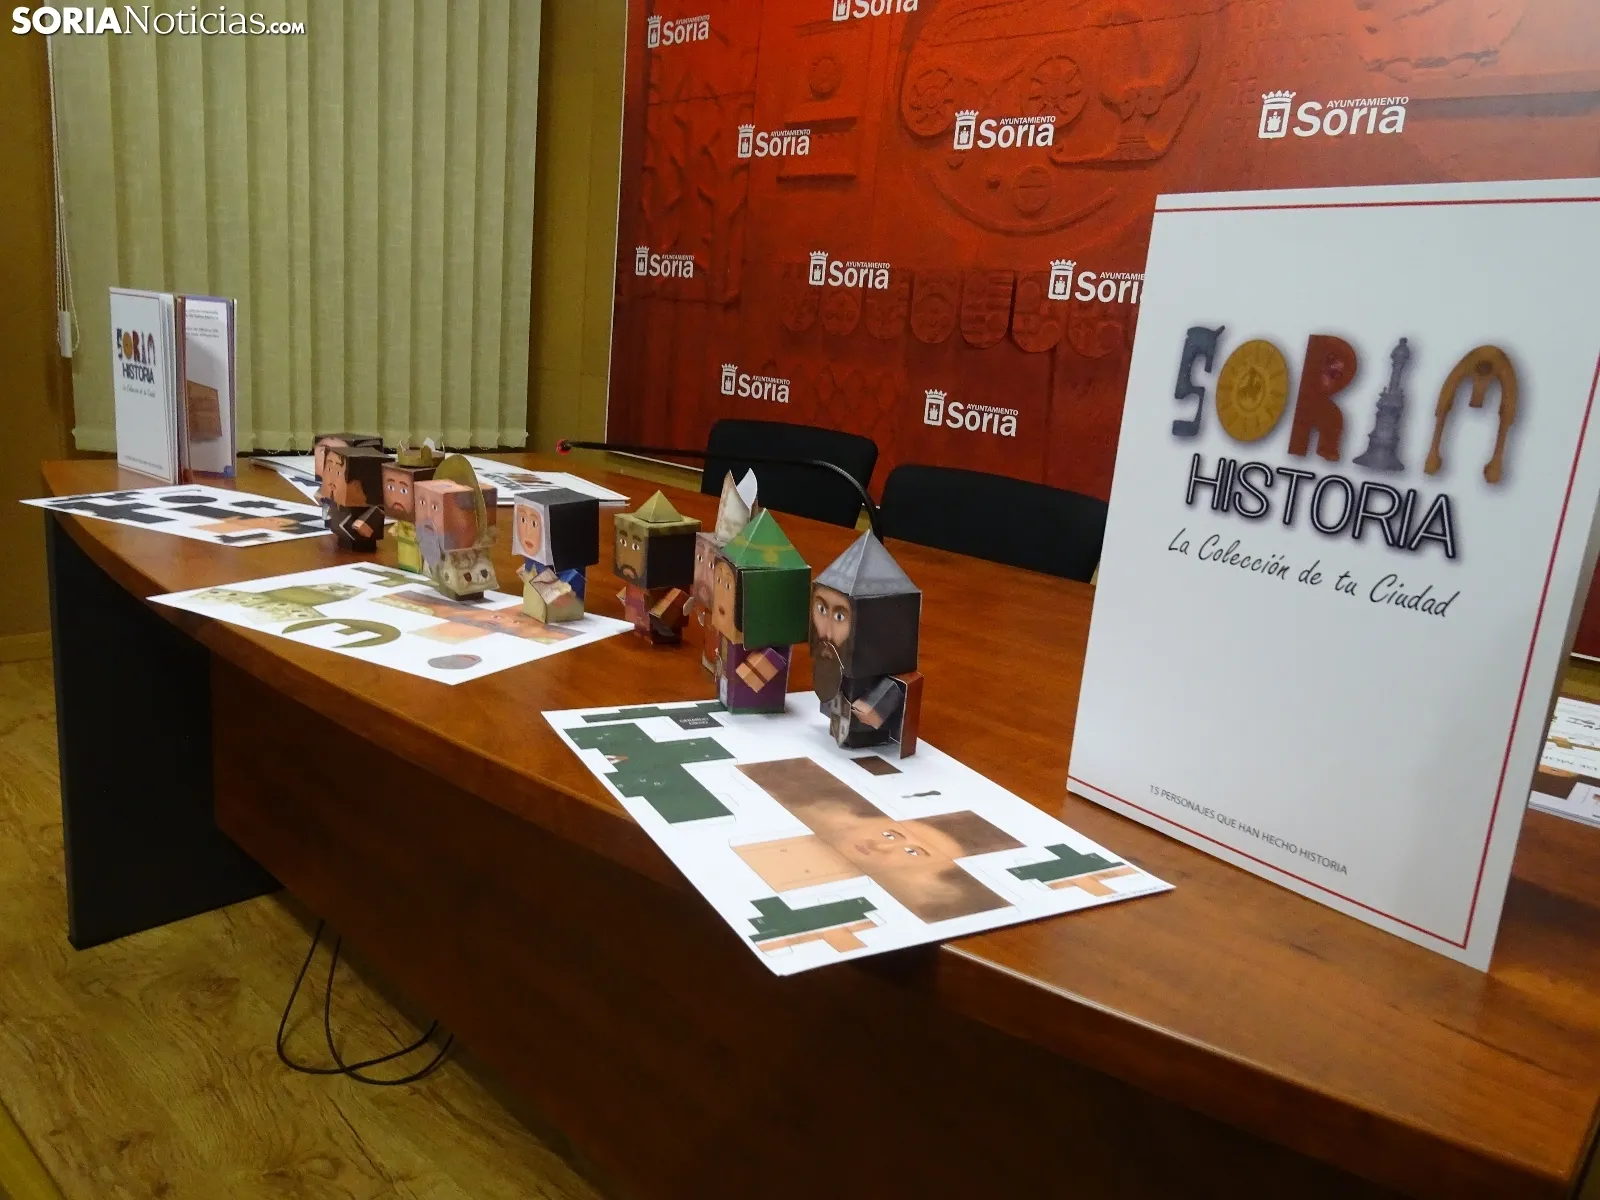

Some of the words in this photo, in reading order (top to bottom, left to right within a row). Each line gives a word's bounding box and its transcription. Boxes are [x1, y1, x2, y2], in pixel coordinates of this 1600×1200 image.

[662, 20, 710, 46] Soria
[675, 15, 710, 25] AYUNTAMIENTO
[1327, 96, 1409, 108] AYUNTAMIENTO
[1000, 115, 1056, 125] AYUNTAMIENTO
[1293, 101, 1408, 137] Soria
[754, 131, 810, 158] Soria
[770, 129, 811, 138] AYUNTAMIENTO
[977, 119, 1055, 148] Soria
[649, 253, 694, 279] Soria
[828, 260, 889, 289] Soria
[846, 261, 890, 269] AYUNTAMIENTO
[1099, 271, 1146, 281] AYUNTAMIE
[1074, 271, 1144, 304] Sori
[116, 328, 156, 366] SORIA
[122, 362, 155, 385] HISTORIA
[752, 375, 791, 385] AYUNTAMIENTO
[737, 373, 790, 403] Soria
[966, 403, 1018, 416] AYUNTAMIENTO
[1171, 324, 1520, 484] SORIA
[946, 401, 1017, 437] Soria
[1185, 452, 1458, 561] HISTORIA
[1168, 527, 1189, 556] La
[1197, 533, 1291, 581] Colección
[1297, 559, 1322, 587] de
[1334, 569, 1357, 597] tu
[1369, 573, 1461, 618] Ciudad
[1149, 784, 1160, 796] 15
[1160, 788, 1215, 819] PERSONAJES
[1216, 813, 1236, 829] QUE
[1238, 822, 1260, 839] HAN
[1261, 831, 1298, 854] HECHO
[1298, 847, 1348, 876] HISTORIA
